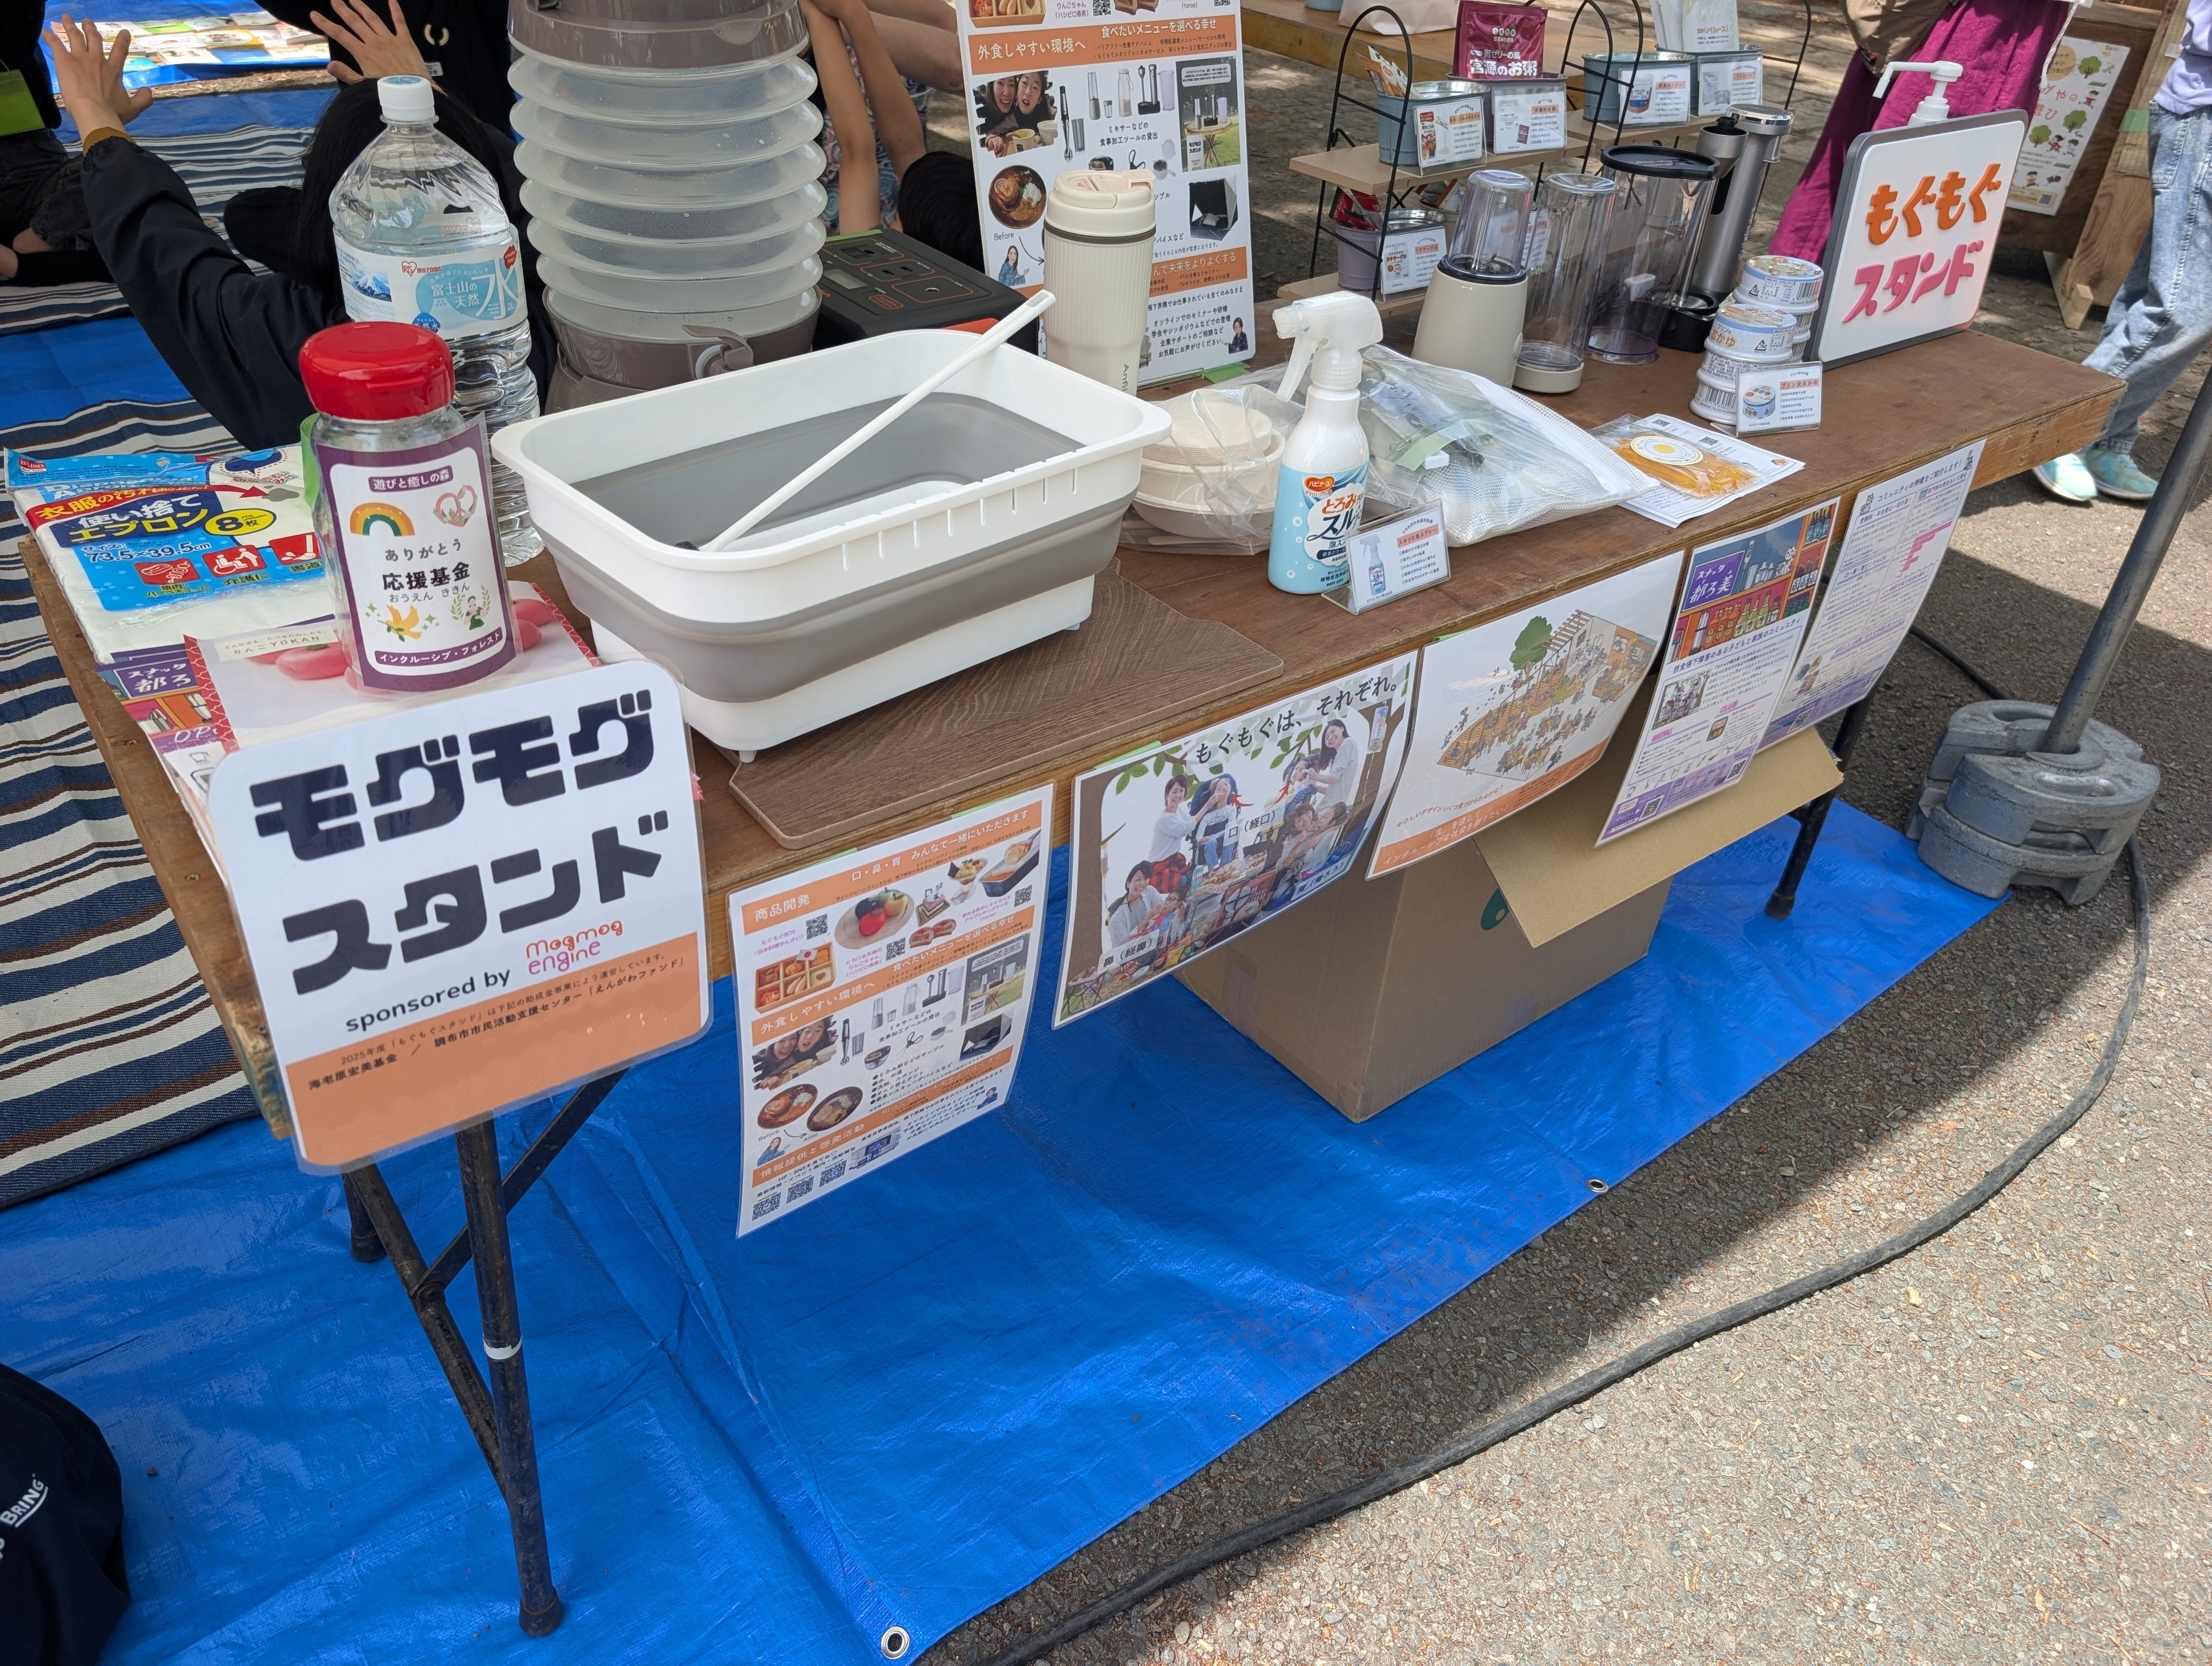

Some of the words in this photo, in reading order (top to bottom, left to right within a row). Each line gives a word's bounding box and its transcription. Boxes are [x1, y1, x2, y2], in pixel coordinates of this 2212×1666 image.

[1101, 18, 1217, 39] 食べたいメニューを選べる幸せ
[978, 38, 1085, 60] 外食しやすい環境へ
[1470, 59, 1538, 76] 宮源のお粥
[1108, 122, 1149, 133] ミキサーなどの
[1866, 163, 2002, 245] もぐもぐ
[994, 231, 1014, 241] Before
[1152, 243, 1218, 258] 取りそろえる内容が変更になります。
[1151, 252, 1236, 277] んで未来をよりよくする
[432, 281, 477, 297] 富士山の
[471, 257, 518, 320] 水
[1843, 240, 1984, 323] スタンド
[455, 293, 480, 307] 天然
[1154, 306, 1228, 327] オンラインでのセミナーや研修
[1711, 328, 1735, 348] おかゆ
[373, 469, 451, 490] 遊びと癒しの森
[79, 494, 202, 529] 使い捨て
[1322, 493, 1357, 514] とろみ
[69, 509, 209, 543] エプロン
[385, 538, 462, 562] ありがとう
[383, 561, 470, 591] 応援基金
[1695, 562, 1726, 581] スナック
[389, 592, 434, 604] おうえん
[441, 583, 470, 598] ききん
[1687, 569, 1736, 606] 都ろ美
[380, 632, 501, 664] インクルーシブ・フォレスト
[128, 663, 187, 679] スナック
[1197, 710, 1302, 764] もぐもぐは、
[1316, 676, 1397, 717] それぞれ。
[249, 689, 655, 861] モグモグ
[1396, 806, 1442, 827] やさしいデザイン
[755, 890, 811, 924] 商品開発
[910, 809, 1028, 861] みんなで一緒にいただきます
[282, 810, 669, 995] スタンド
[526, 920, 623, 959] mogmog
[761, 927, 796, 946] もぐもぐBOX
[893, 913, 1015, 972] 食べたいメニューを選べる幸せ
[528, 938, 601, 976] engine
[848, 953, 879, 970] りんごちゃん
[340, 954, 666, 1065] 2025年度「もぐもぐスタンド」は下記の助成金事業により運営しています。
[346, 981, 475, 1033] sponsored
[485, 969, 511, 989] by
[761, 977, 875, 1035] 外食しやすい環境へ
[308, 1054, 398, 1091] 海老原宏美基金
[434, 957, 684, 1048] 調布市市民活動支援センター「えんがわファンド」
[758, 1127, 779, 1142] Before
[803, 1131, 819, 1143] After
[760, 1122, 865, 1179] 情報提供と啓発活動
